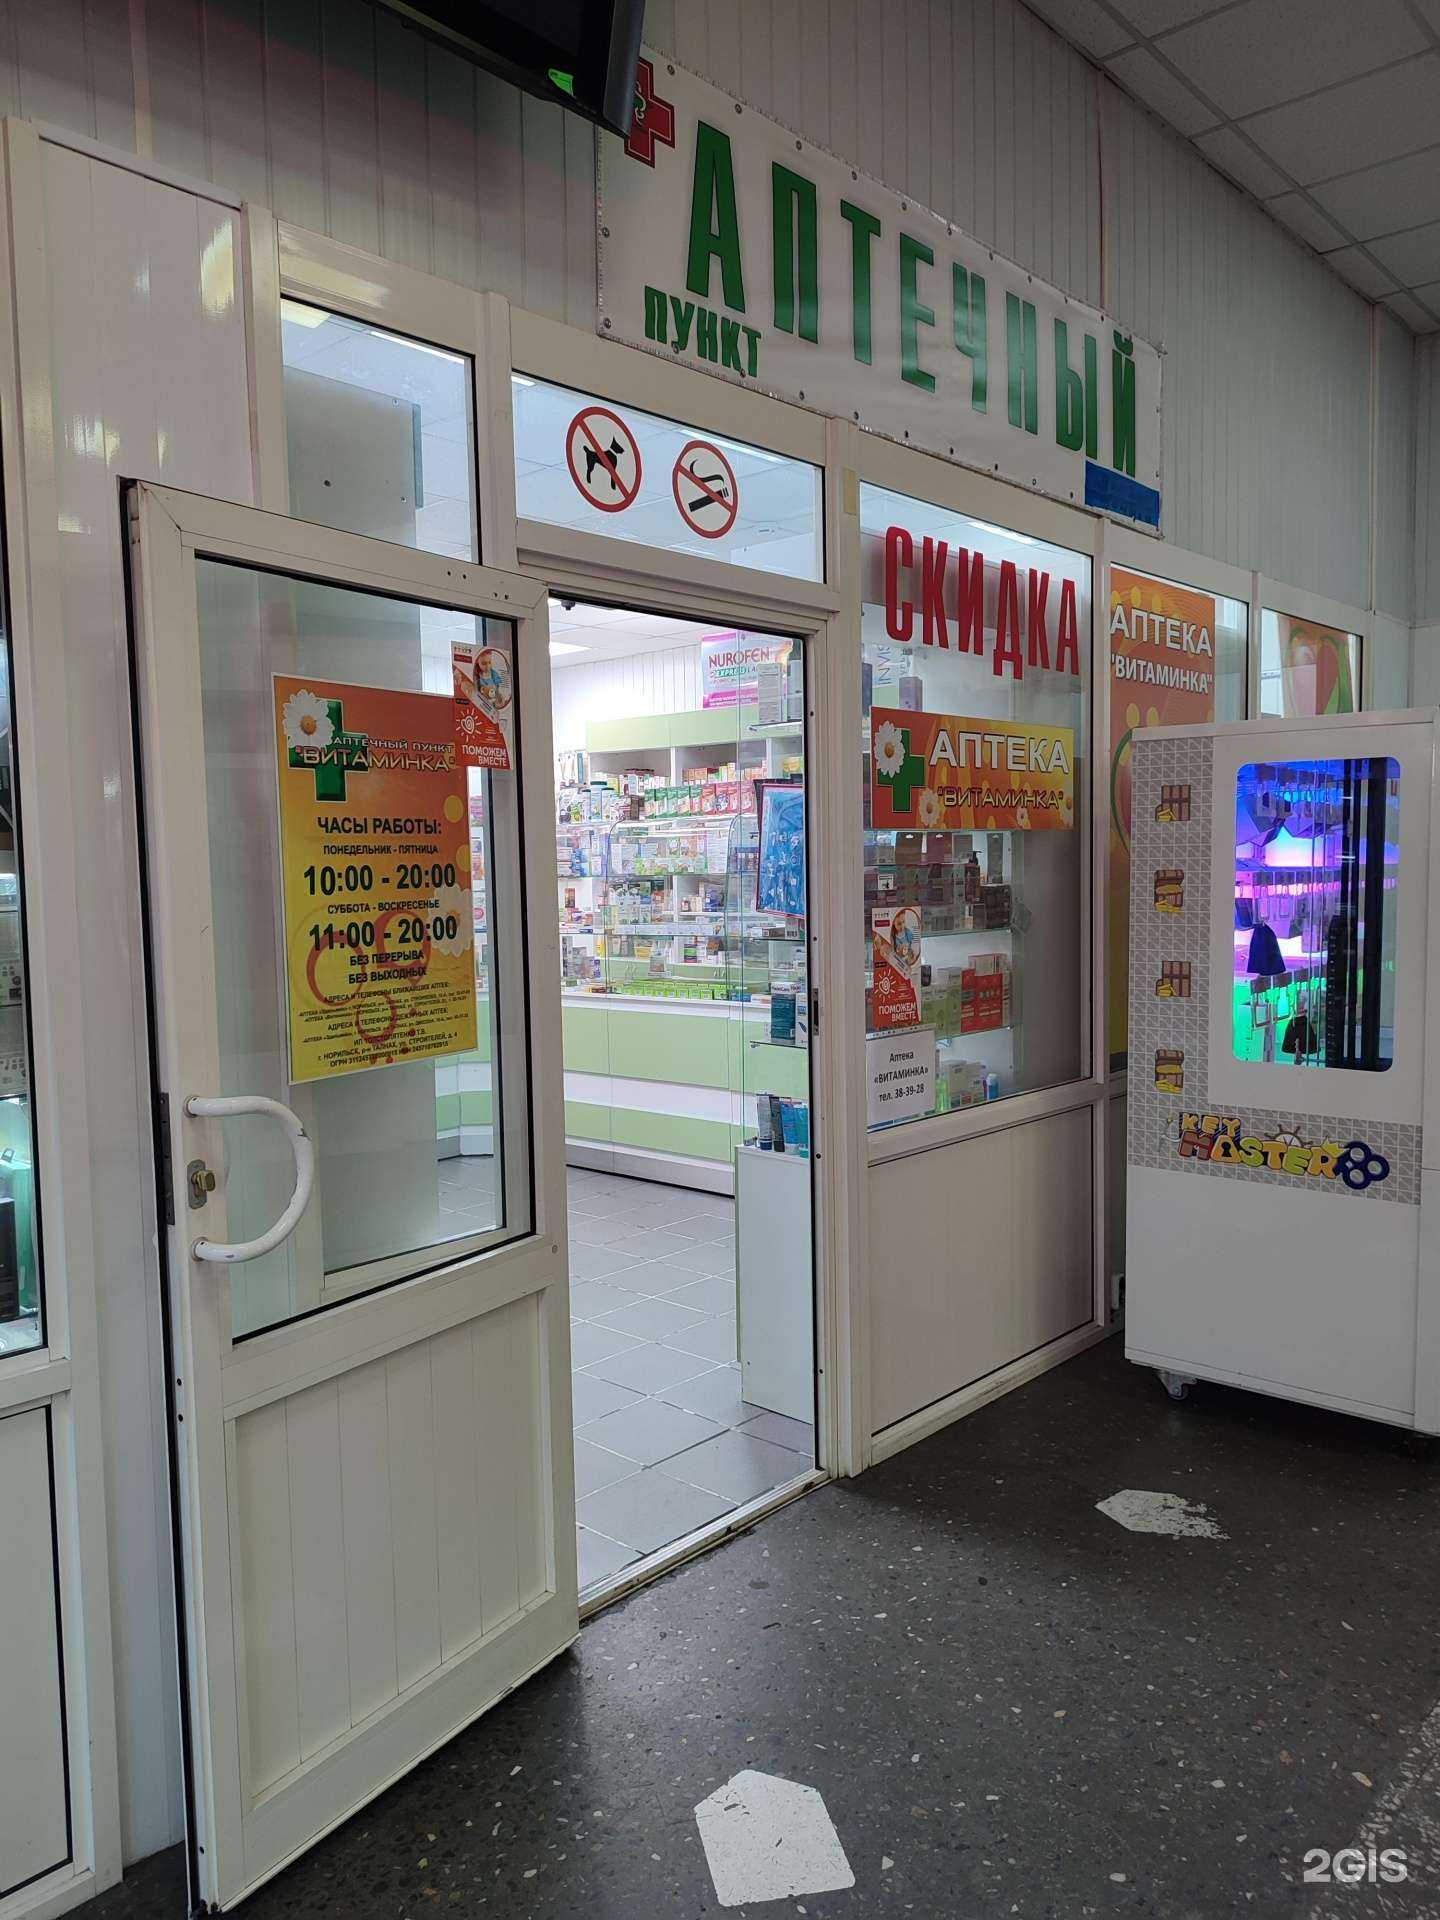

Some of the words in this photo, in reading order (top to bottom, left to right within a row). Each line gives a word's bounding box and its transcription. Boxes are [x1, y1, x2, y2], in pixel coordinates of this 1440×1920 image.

[685, 119, 1136, 478] АПТЕЧНЫЙ
[643, 284, 762, 378] ПУНКТ
[884, 526, 1080, 680] СКИДКА
[1109, 604, 1214, 659] АПТЕКА
[708, 647, 770, 668] NUROFEN
[332, 736, 408, 750] АПТЕЧНЫЙ
[412, 742, 454, 754] ПУНКТ
[462, 744, 507, 757] ПОМОЖЕМ
[929, 730, 1070, 775] АПТЕКА
[478, 756, 507, 767] ВМЕСТЕ
[317, 816, 368, 834] ЧАСЫ
[372, 818, 443, 835] РАБОТЫ:
[323, 844, 392, 856] ПОНЕДЕЛЬНИК
[398, 844, 439, 855] ПЯТНИЦА
[303, 865, 373, 896] 10:00
[396, 863, 456, 889] 20:00
[327, 900, 371, 915] СУББОТА
[378, 899, 440, 912] ВОСКРЕСЕНЬЕ
[309, 921, 375, 951] 11:00
[398, 915, 458, 944] 20:00
[349, 952, 369, 966] БЕЗ
[372, 950, 424, 964] ПЕРЕРЫВА
[348, 971, 368, 984] БЕЗ
[370, 967, 427, 982] ВЫХОДНЫХ
[878, 1003, 918, 1015] ПОМОЖЕМ
[891, 1011, 918, 1022] ВМЕСТЕ
[889, 1050, 914, 1064] Аптека
[874, 1066, 929, 1084] «ВИТАМИНКА»
[878, 1091, 893, 1103] тел.
[894, 1083, 925, 1099] 38-39-28
[1180, 1112, 1241, 1137] KEY
[1178, 1130, 1338, 1180] MASTER
